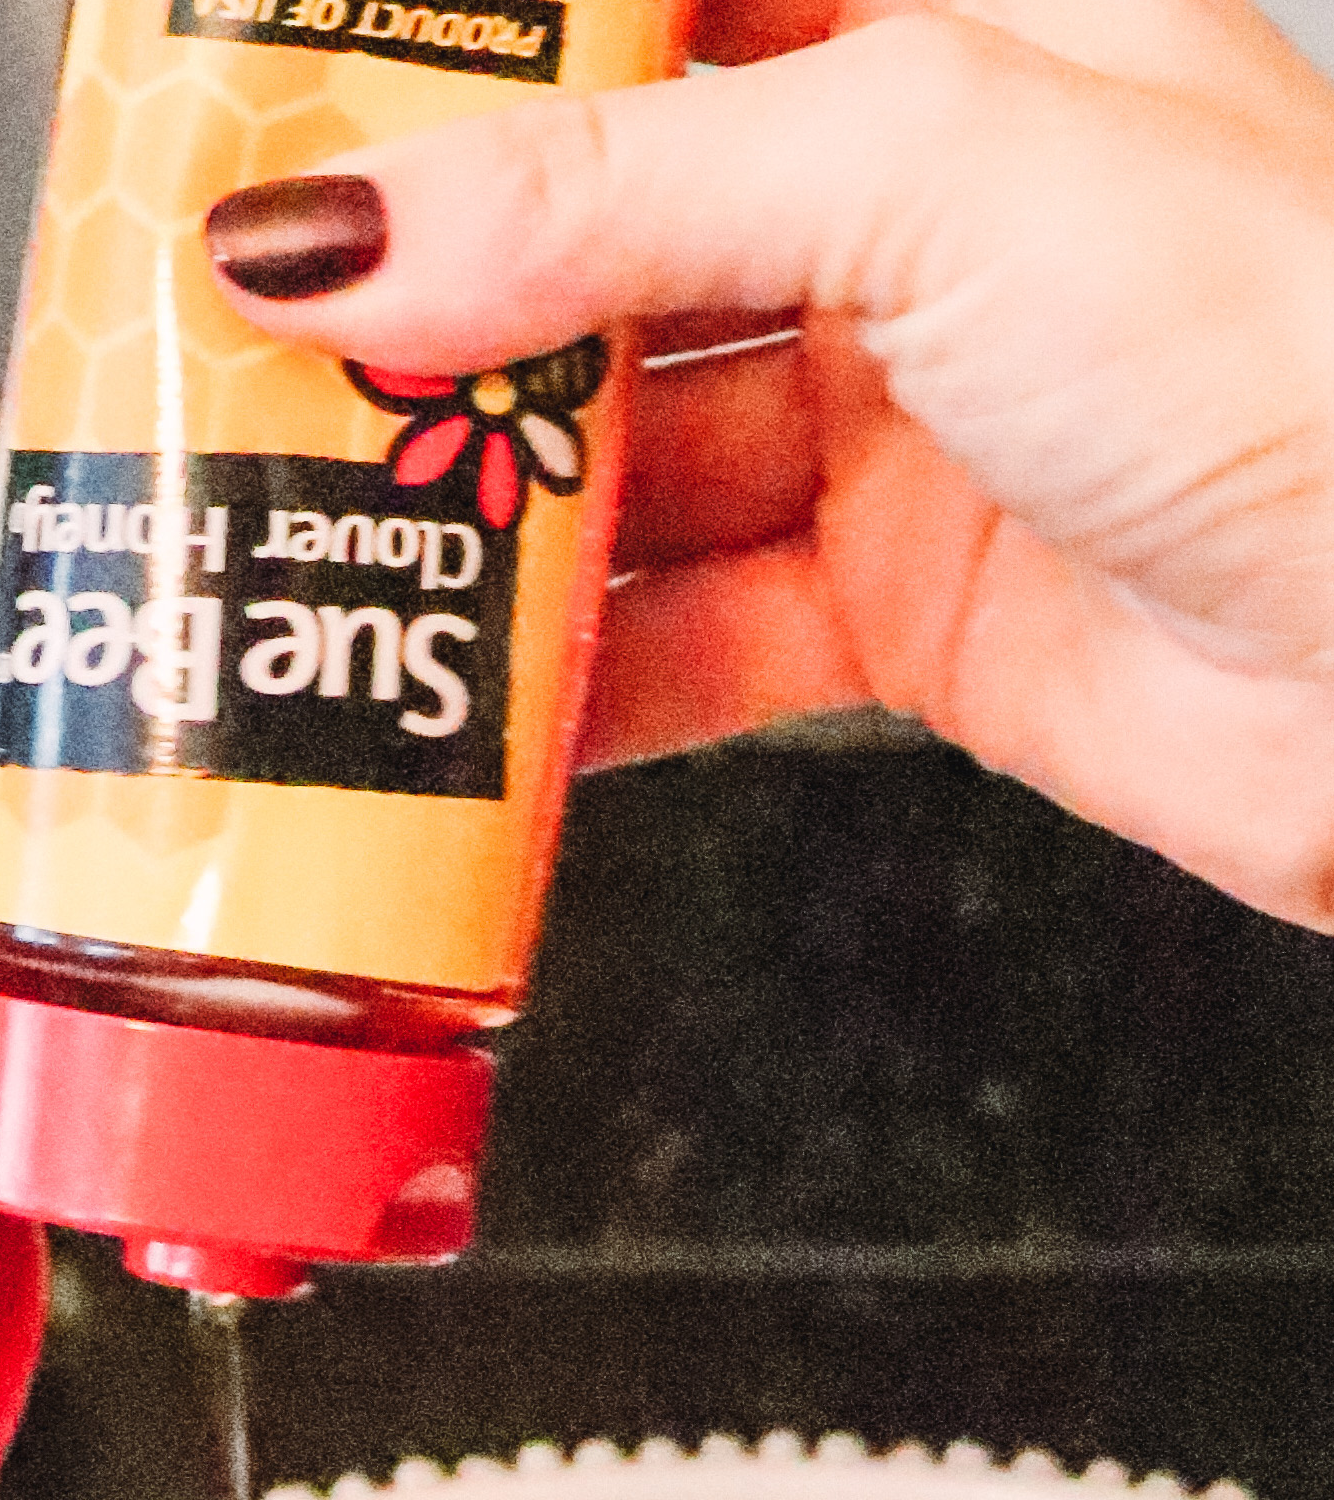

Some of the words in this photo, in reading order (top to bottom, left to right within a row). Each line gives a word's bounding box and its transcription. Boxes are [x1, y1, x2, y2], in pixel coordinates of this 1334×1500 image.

[349, 1, 546, 56] PRODUCT
[250, 509, 481, 589] Clover
[237, 599, 477, 737] Sue
